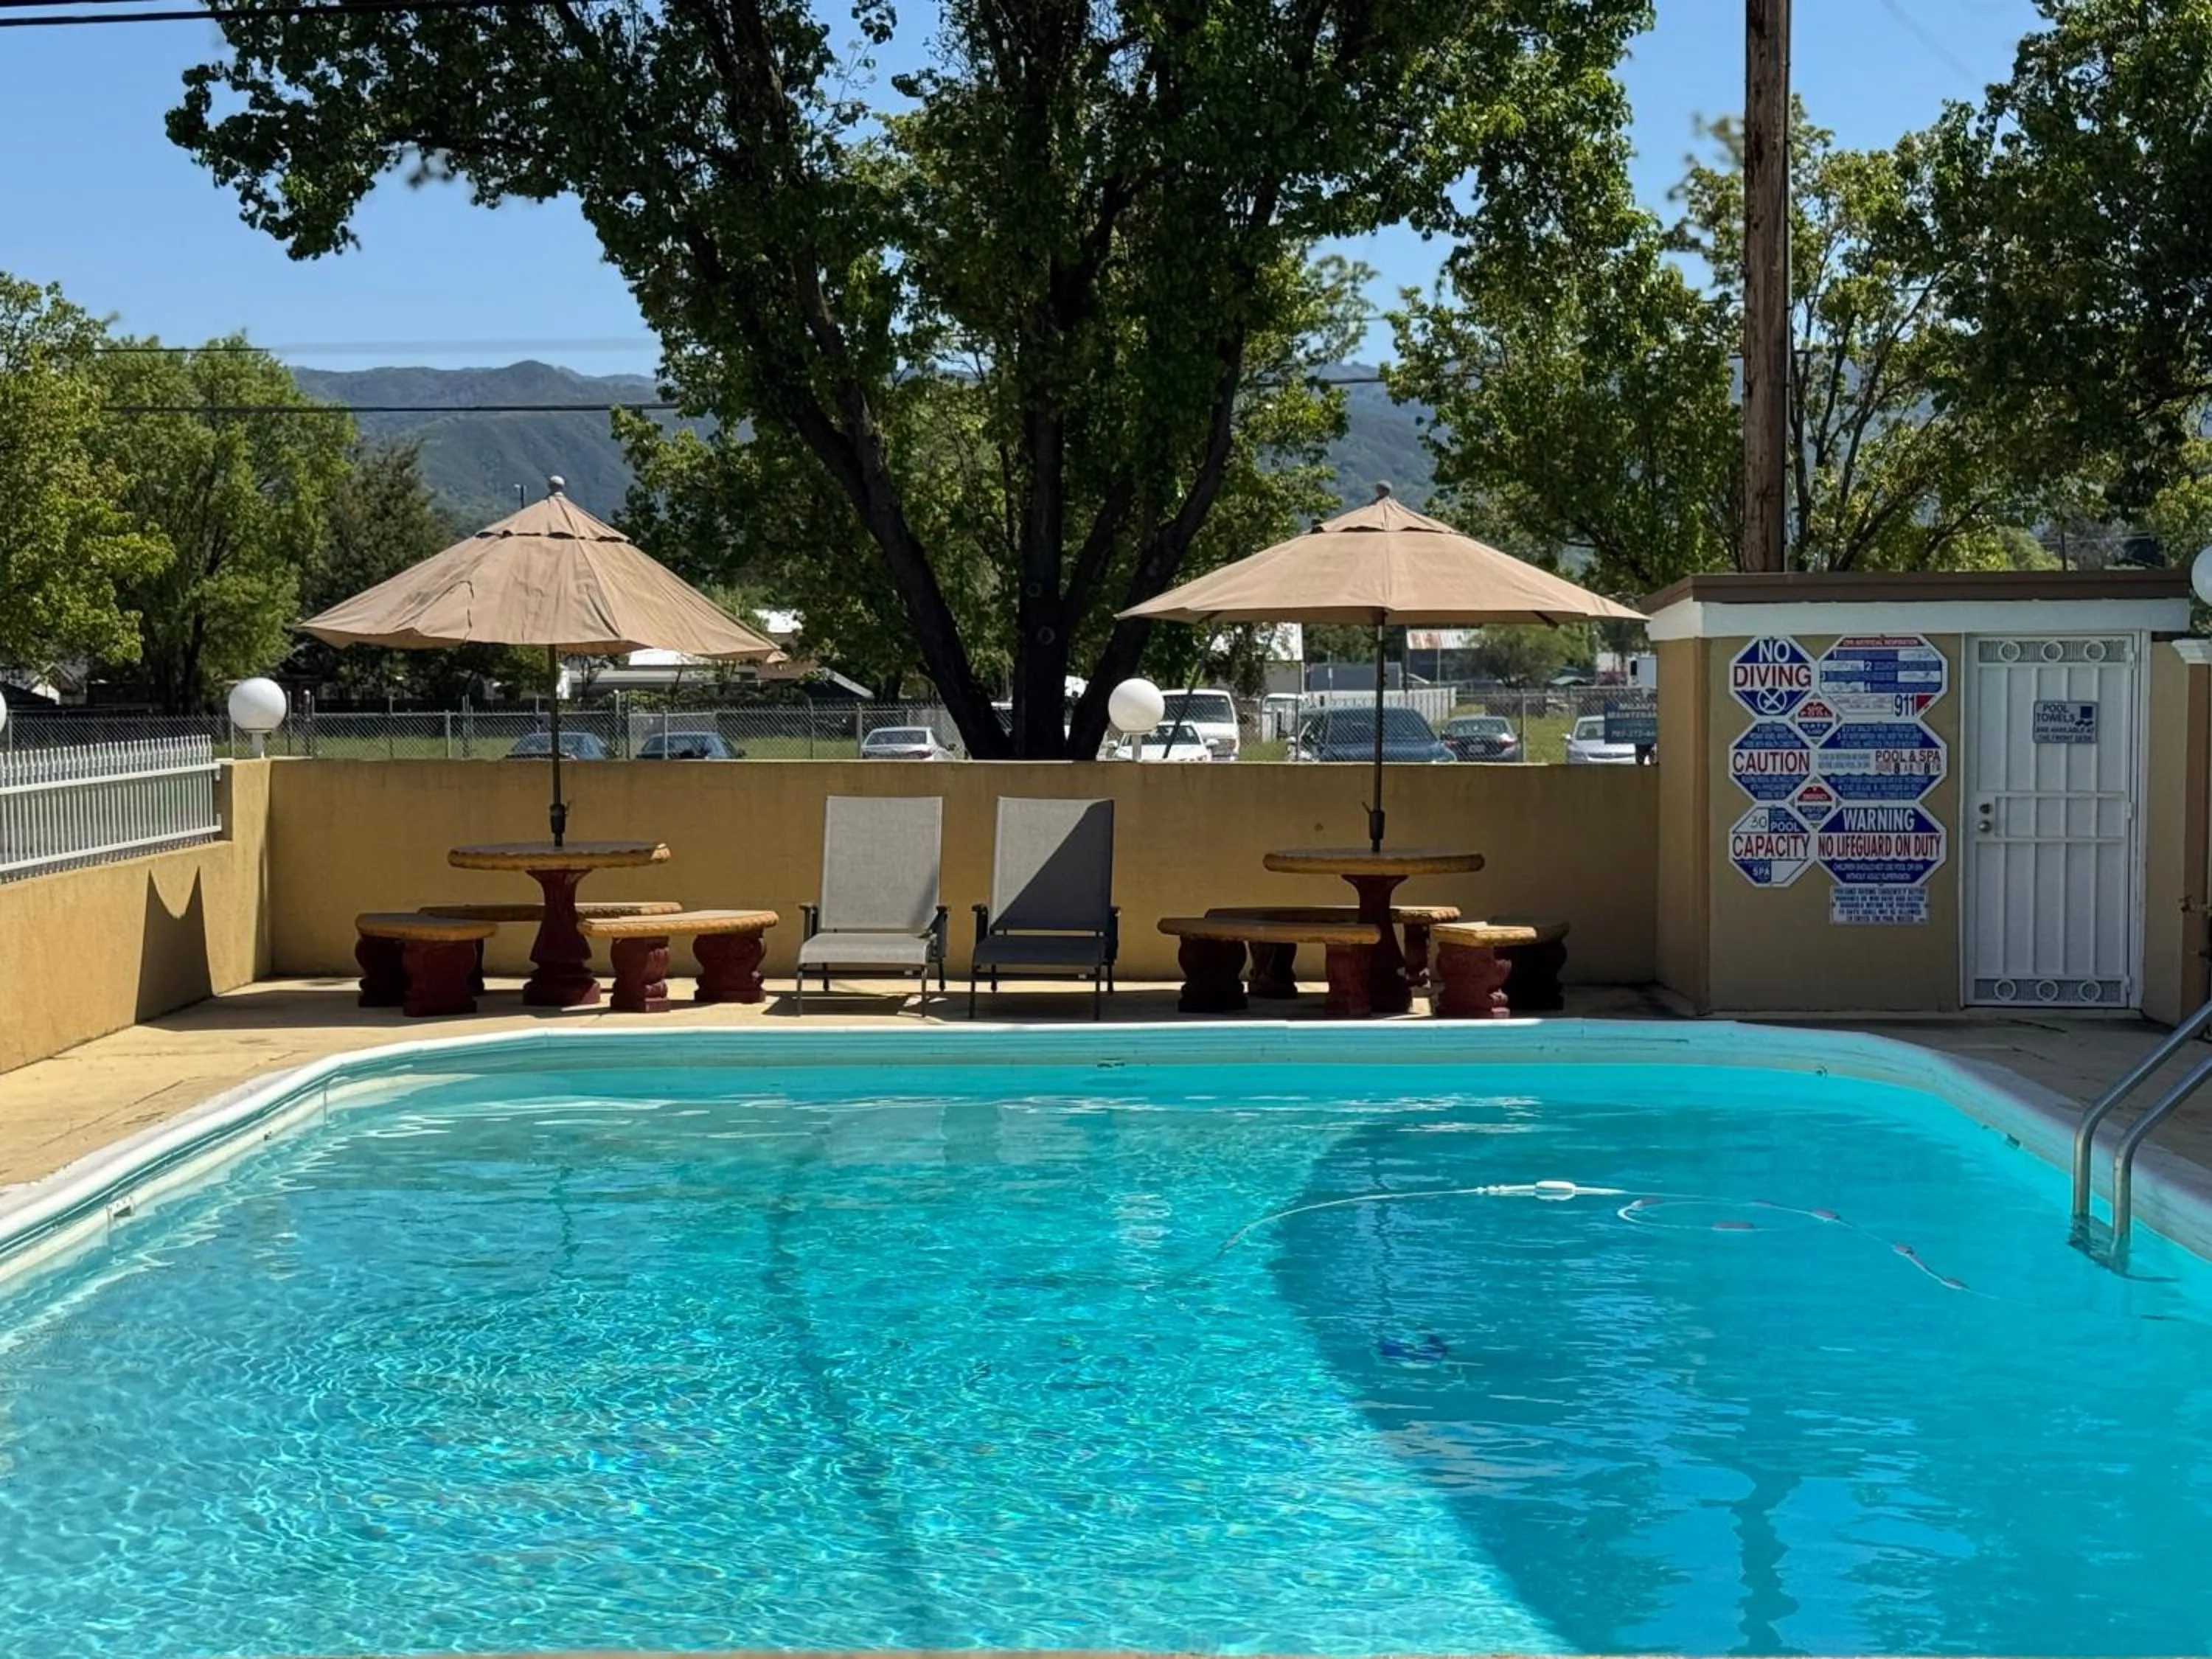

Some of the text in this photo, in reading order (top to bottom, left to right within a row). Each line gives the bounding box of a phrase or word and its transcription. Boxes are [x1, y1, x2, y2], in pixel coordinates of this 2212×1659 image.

[1759, 640, 1790, 662] NO
[1865, 661, 1872, 672] 2
[1733, 665, 1812, 687] DIVING
[1894, 695, 1915, 717] 911
[2043, 704, 2069, 713] POOL
[2037, 713, 2075, 723] TOWELS
[1733, 751, 1810, 773] CAUTION
[1876, 751, 1906, 762] POOL
[1909, 751, 1917, 762] &
[1919, 751, 1941, 762] SPA
[1750, 815, 1767, 829] 30
[1770, 821, 1801, 832] POOL
[1843, 809, 1916, 832] WARNING
[1733, 835, 1811, 858] CAPACITY
[1818, 834, 1941, 857] NO LIFEGUARD ON DUTY
[1752, 866, 1770, 877] SPA
